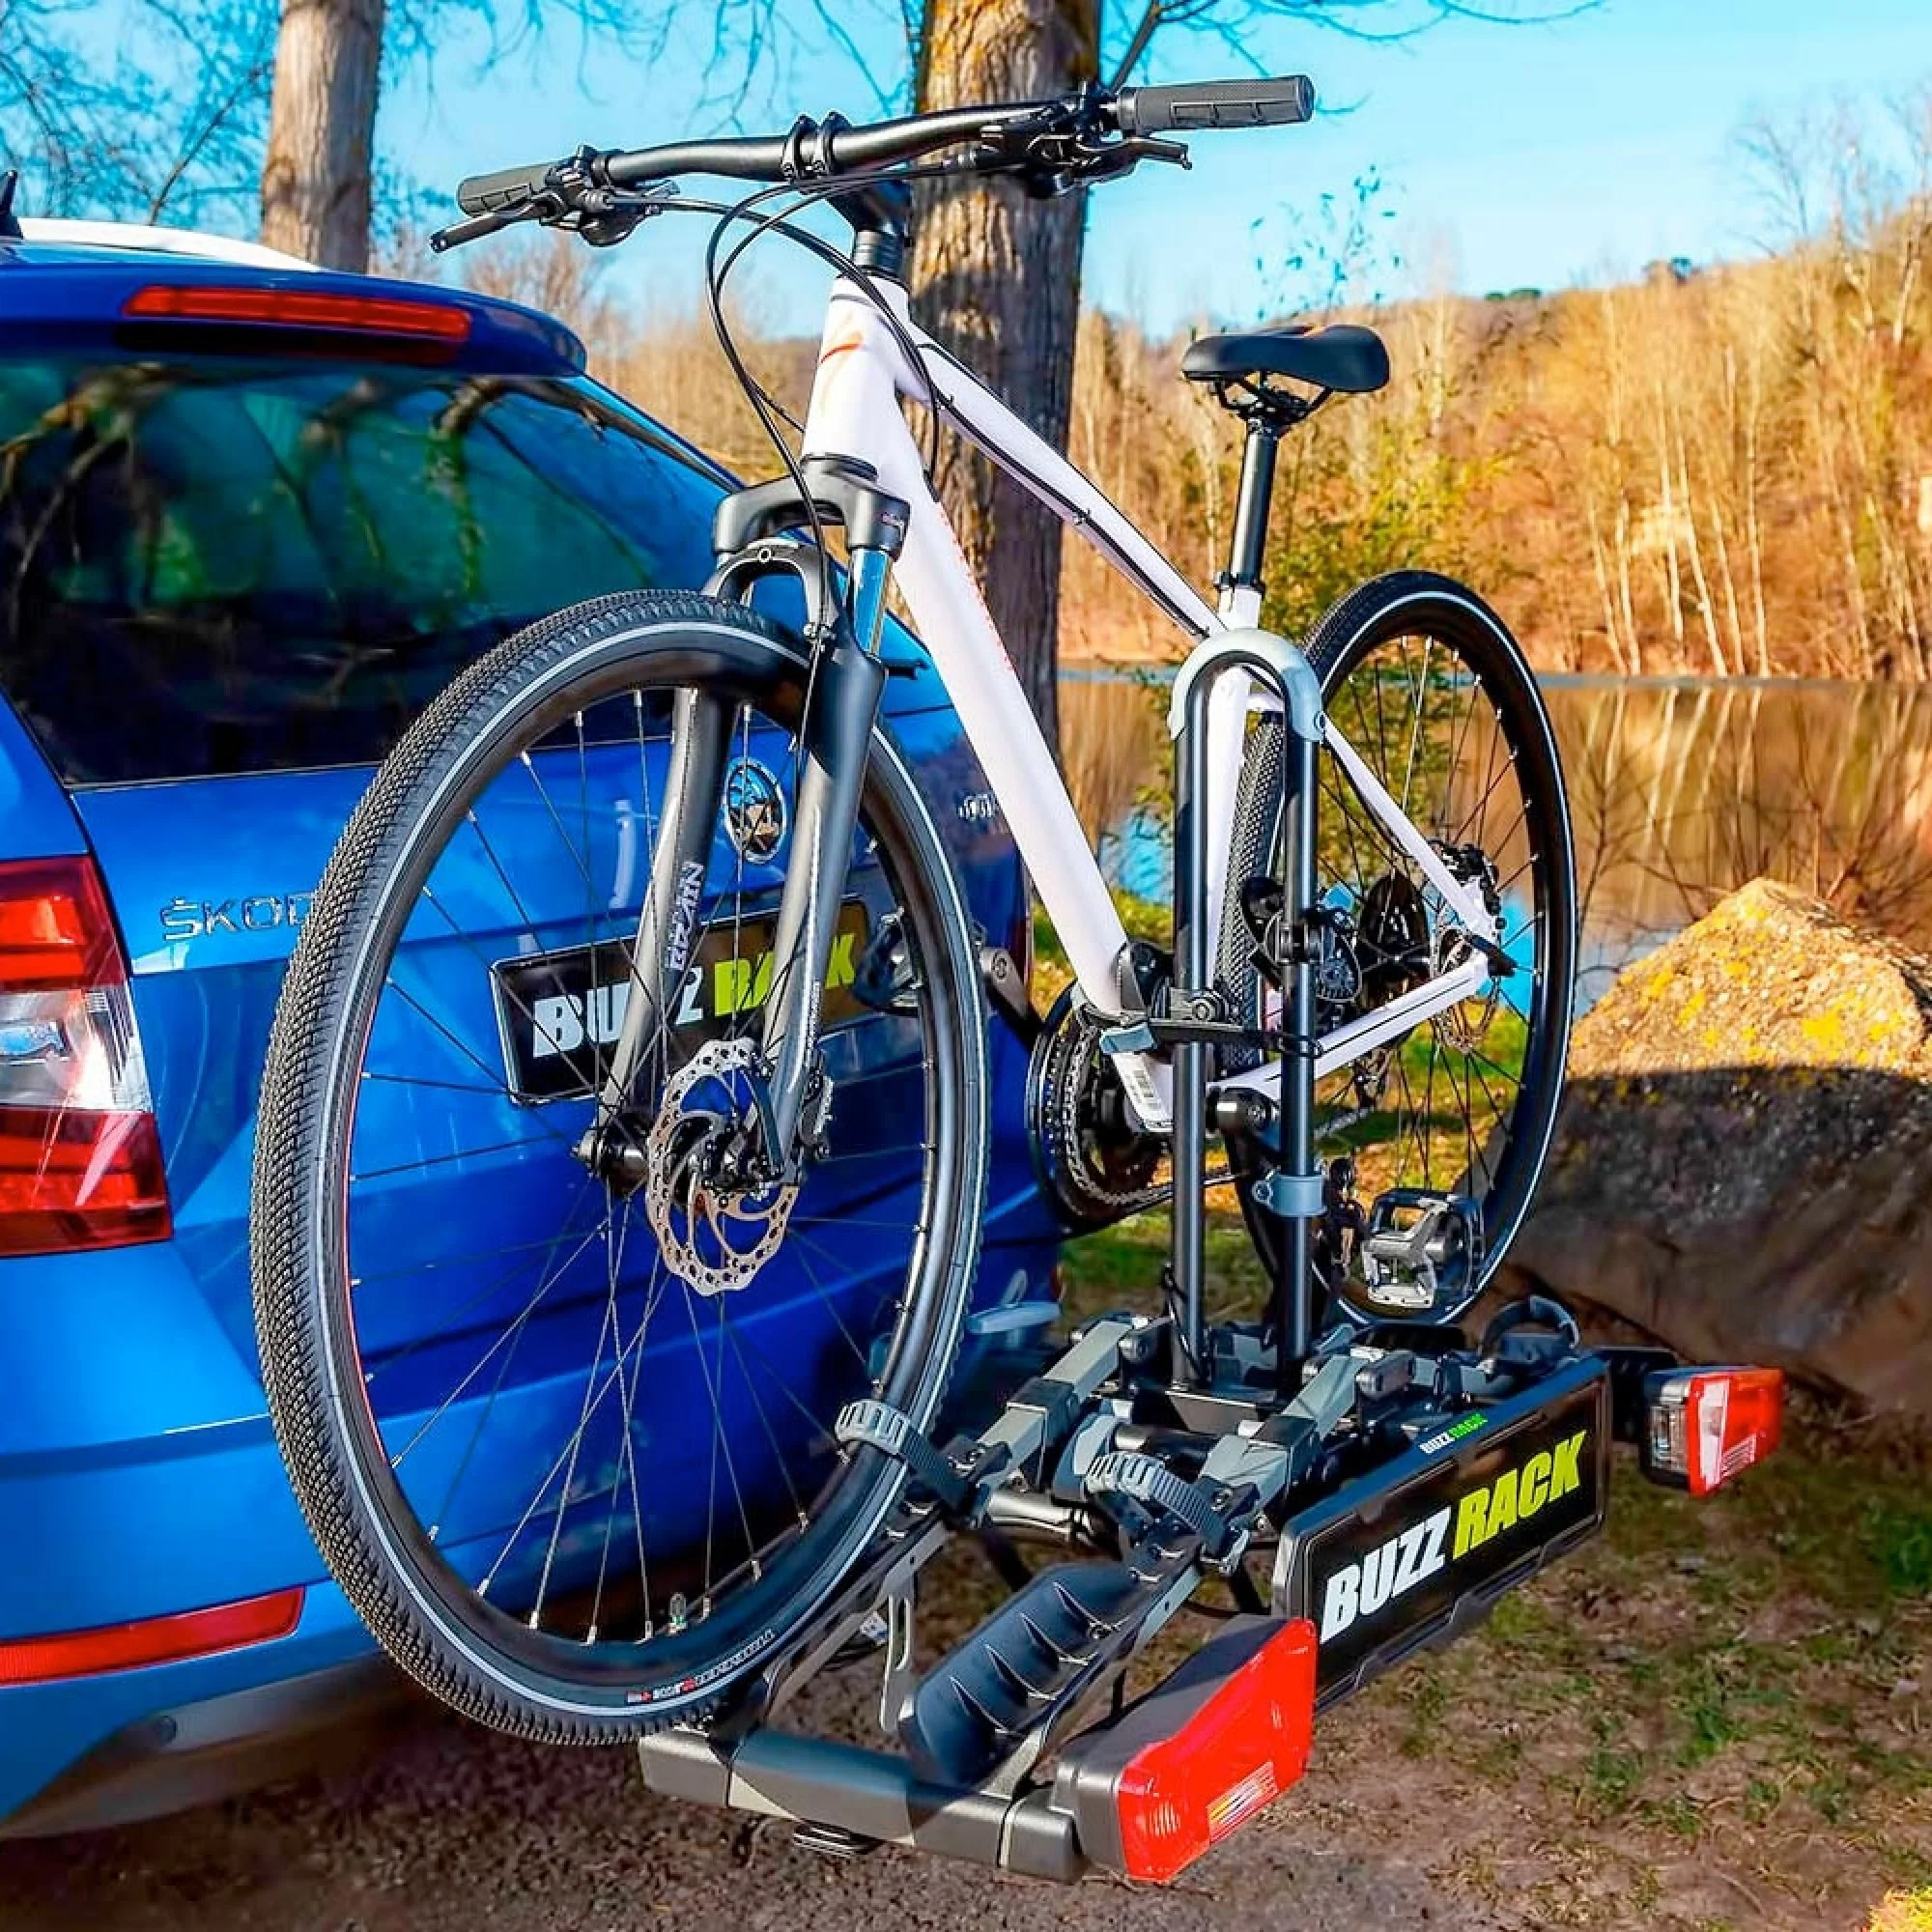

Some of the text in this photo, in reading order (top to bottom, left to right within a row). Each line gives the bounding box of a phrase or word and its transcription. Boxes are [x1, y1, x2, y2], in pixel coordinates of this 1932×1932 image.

[533, 965, 704, 1058] BUZ
[1320, 1429, 1587, 1644] BUZZ RACK
